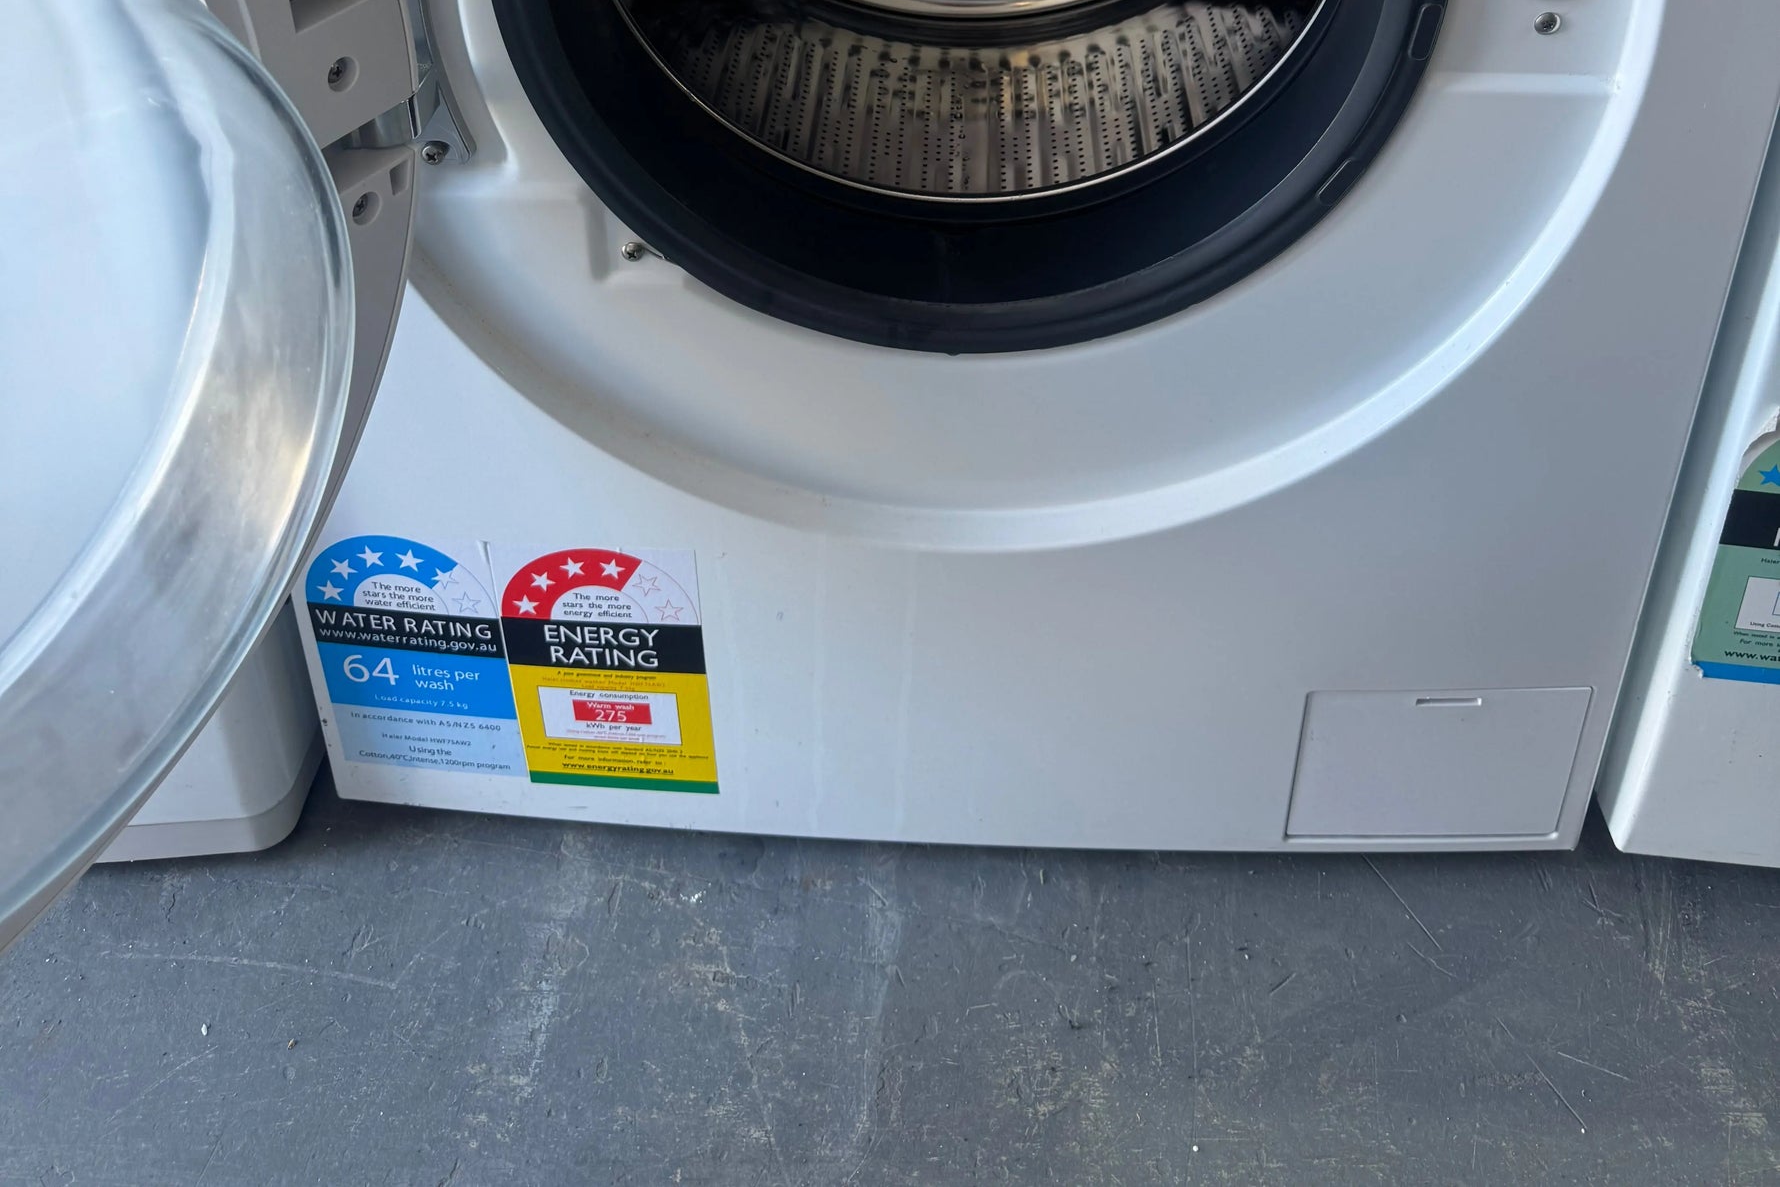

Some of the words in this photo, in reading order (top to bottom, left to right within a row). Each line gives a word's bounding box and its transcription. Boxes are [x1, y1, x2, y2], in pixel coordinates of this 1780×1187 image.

[371, 581, 392, 590] The
[394, 585, 421, 593] more
[362, 590, 386, 598] stars
[389, 592, 406, 600] the
[408, 594, 434, 602] more
[573, 592, 591, 600] The
[364, 598, 392, 607] water
[396, 601, 435, 611] efficient
[588, 601, 603, 609] the
[563, 610, 593, 618] energy
[597, 610, 632, 618] efficient
[315, 607, 396, 632] WATER
[404, 615, 492, 639] RATING
[319, 628, 497, 654] www.waterrating.gov.au
[543, 624, 659, 647] ENERGY
[551, 646, 659, 668] RATING
[343, 654, 399, 686] 64
[412, 664, 452, 680] litres
[455, 669, 480, 683] per
[415, 678, 454, 691] wash
[569, 689, 595, 699] Energy
[599, 692, 649, 701] consumption
[374, 694, 398, 703] Load
[400, 696, 438, 707] capacity
[440, 699, 454, 708] 7.5
[456, 700, 469, 710] kg
[586, 701, 611, 710] Warm
[595, 709, 627, 722] 275
[362, 712, 414, 724] accordance
[416, 717, 437, 726] with
[478, 723, 501, 732] 6400
[586, 722, 605, 730] kWh
[609, 724, 622, 732] per
[625, 725, 642, 733] year
[404, 734, 428, 743] Model
[408, 745, 435, 756] Using
[437, 748, 452, 756] the
[476, 762, 511, 772] program
